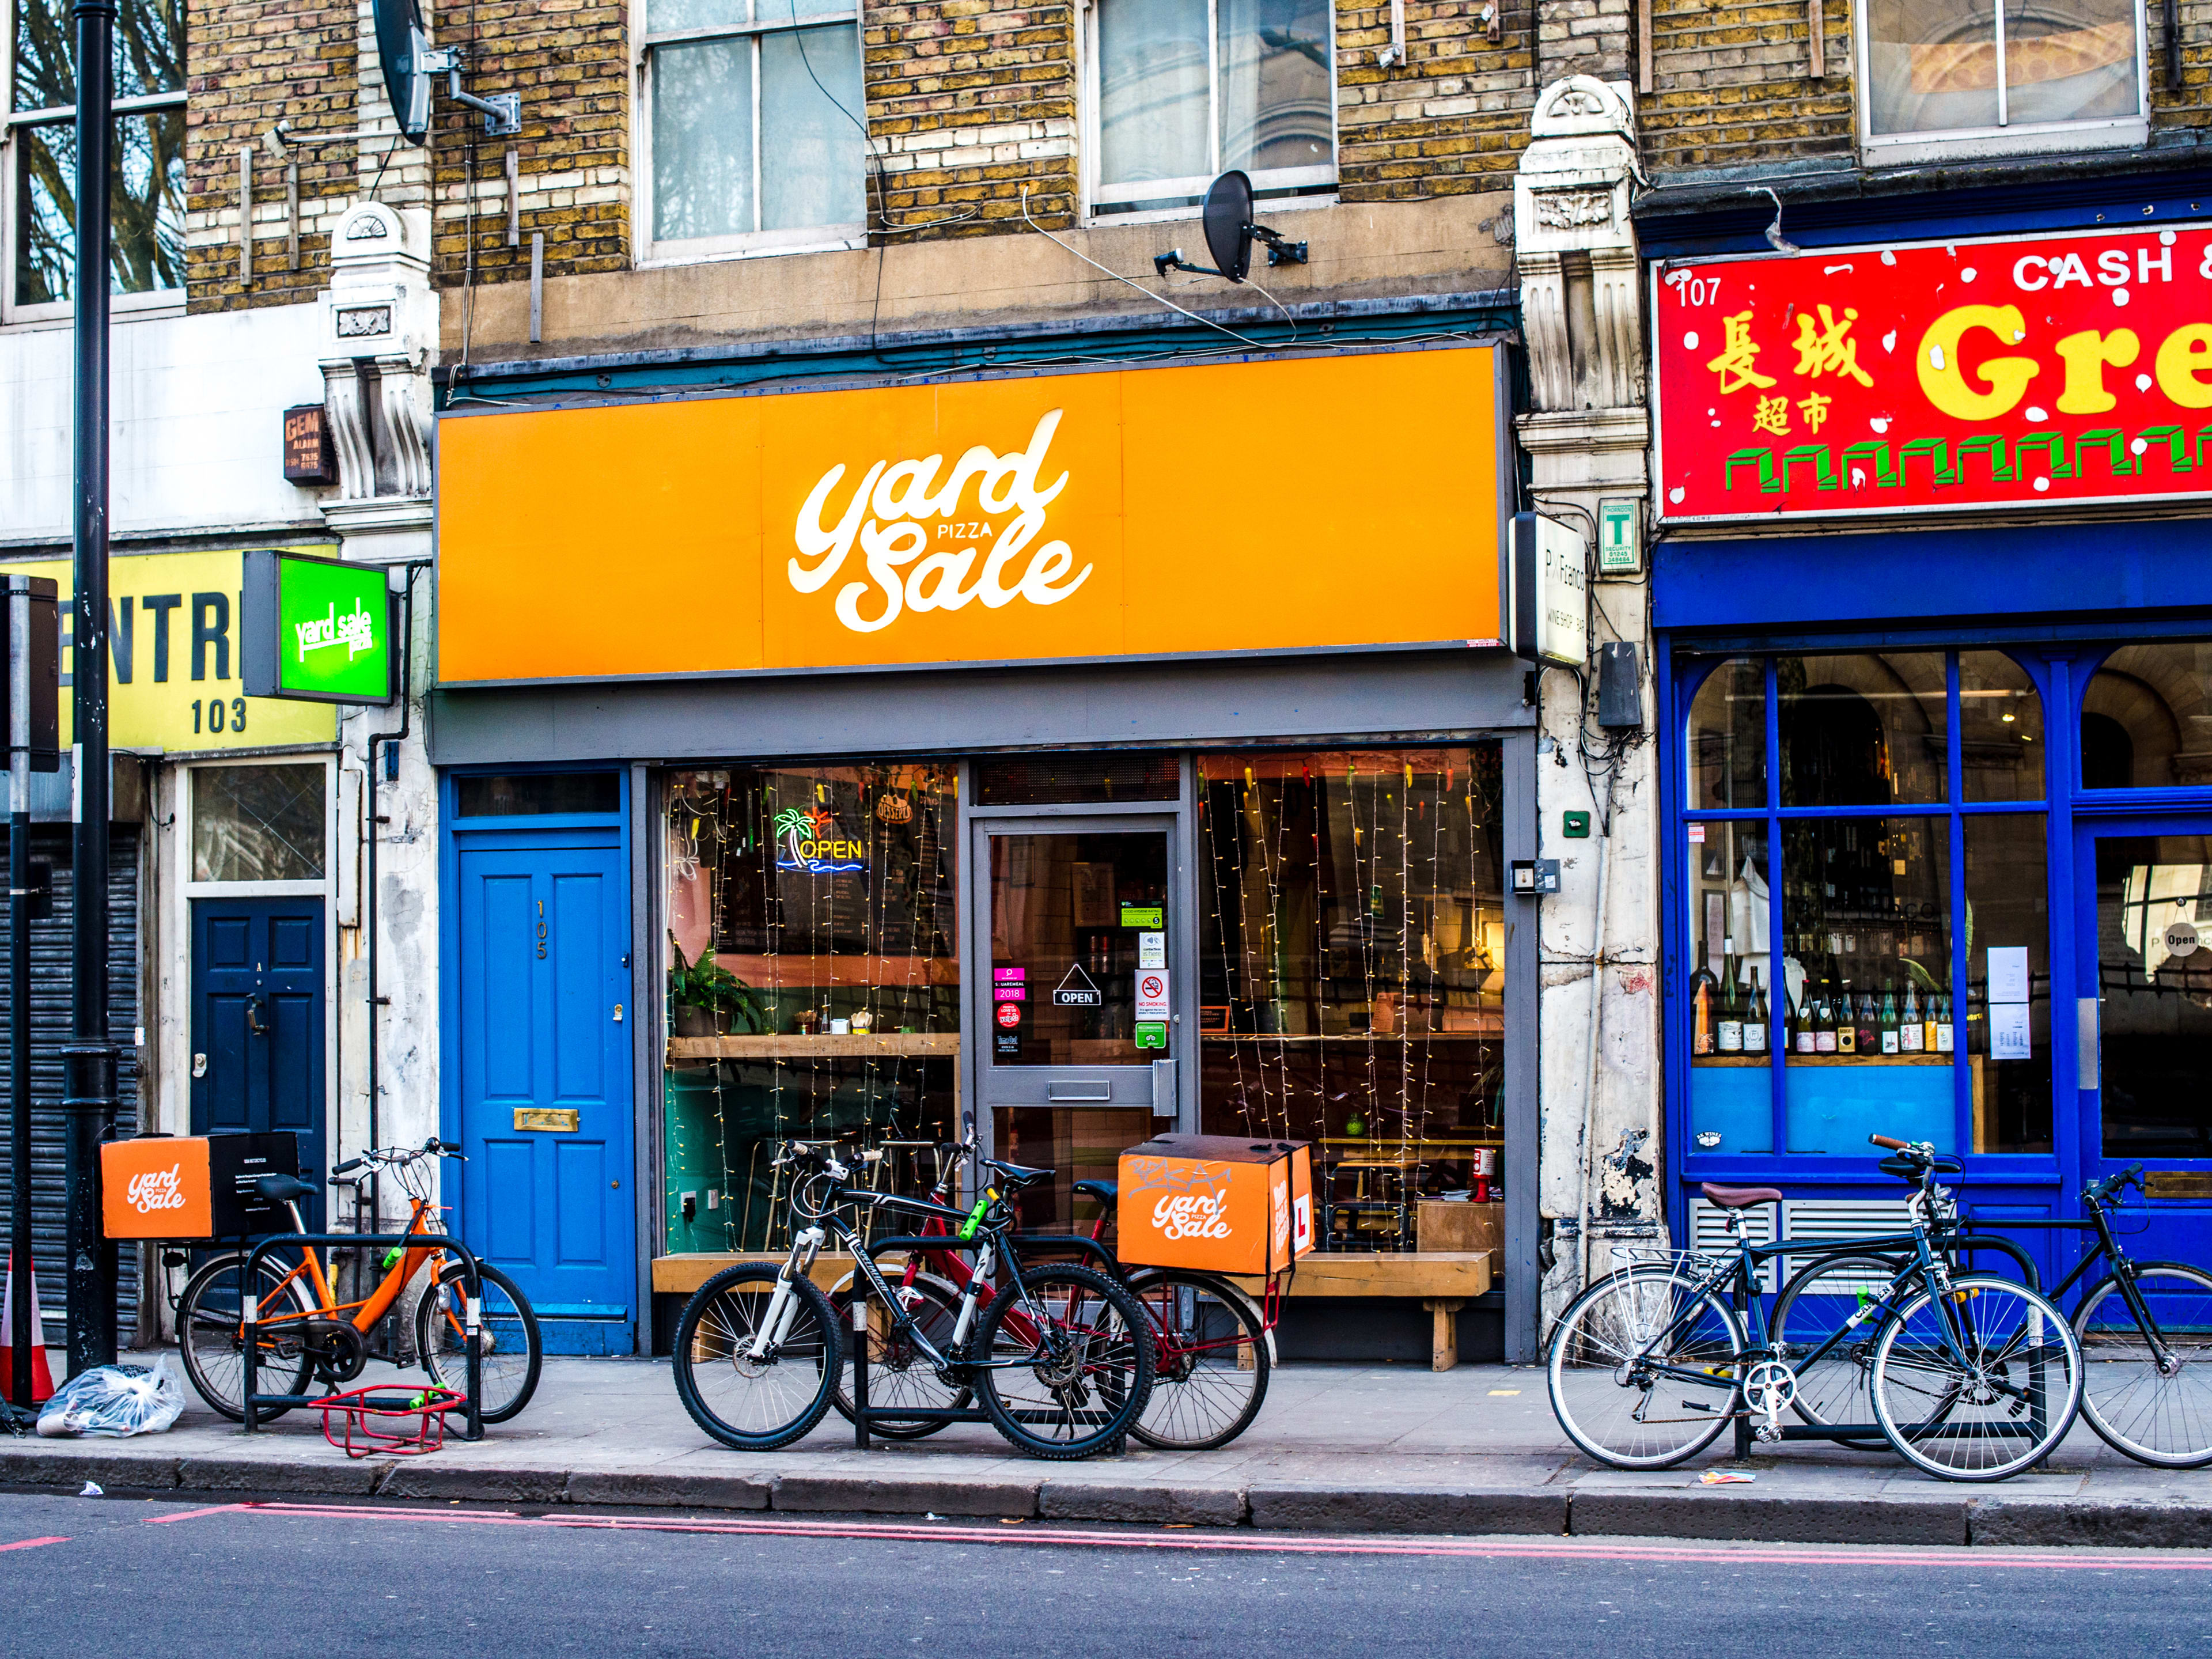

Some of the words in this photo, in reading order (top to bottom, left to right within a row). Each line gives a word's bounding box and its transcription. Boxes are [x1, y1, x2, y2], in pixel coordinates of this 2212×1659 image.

[2013, 247, 2172, 291] CASH
[1676, 277, 1721, 307] 107
[1707, 304, 1874, 394] 長城
[1916, 304, 2212, 421] Gre
[1752, 391, 1832, 436] 超市
[293, 438, 319, 450] ALARM
[937, 522, 993, 539] PIZZA
[1607, 514, 1630, 544] T
[835, 507, 1093, 632] Sale
[59, 588, 243, 685] ENTR
[295, 601, 335, 662] yard
[337, 597, 372, 637] sale
[192, 698, 247, 734] 103
[878, 802, 911, 819] DESSERTS
[800, 840, 861, 859] OPEN
[537, 900, 547, 960] 105
[2168, 935, 2195, 946] Open
[1000, 990, 1020, 998] 2018
[1062, 993, 1093, 1003] OPEN
[137, 1185, 185, 1213] Sale
[1164, 1213, 1232, 1240] Sale
[1298, 1207, 1305, 1238] L
[1855, 1286, 1891, 1318] CAMEN
